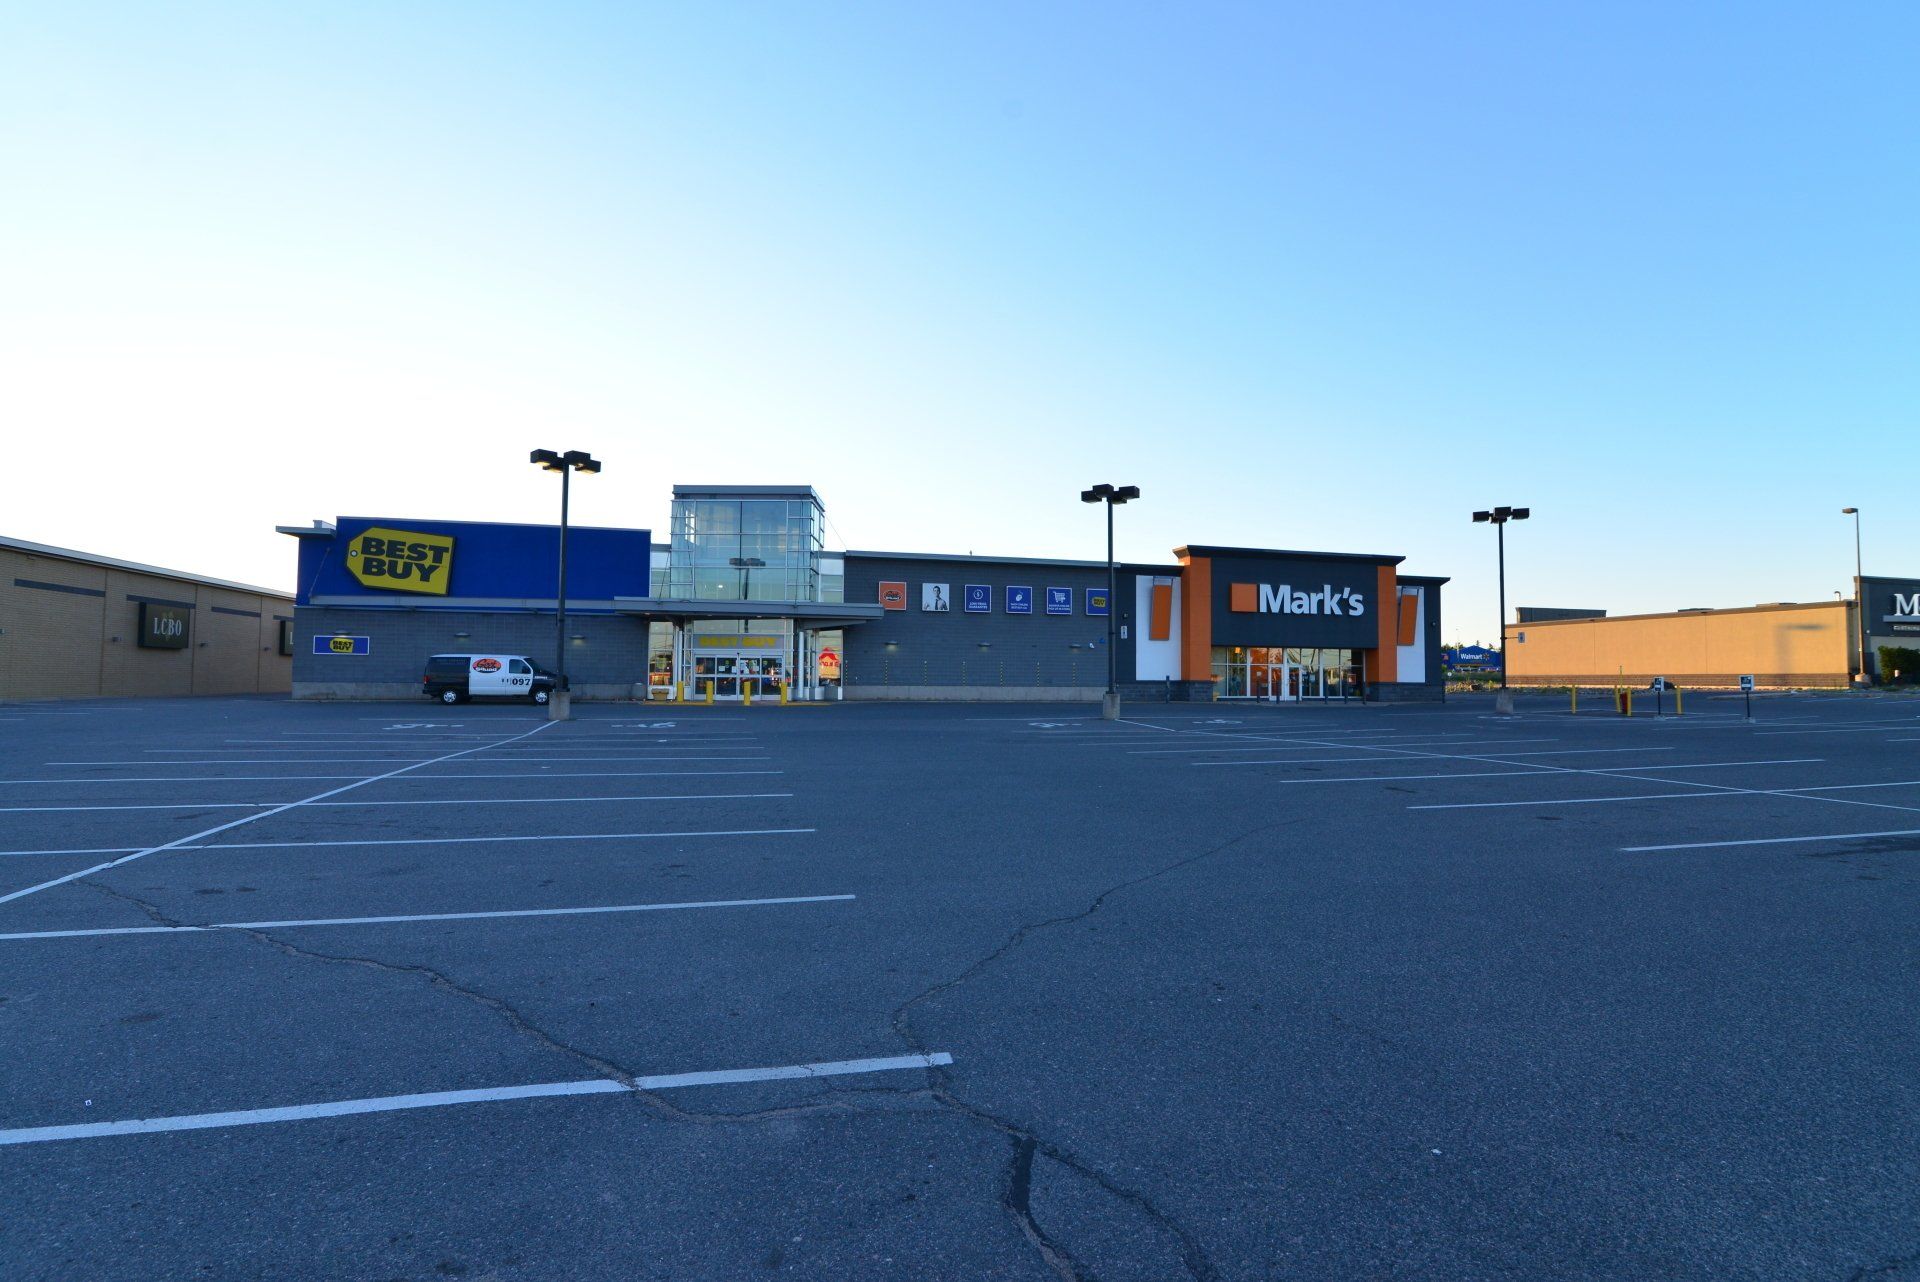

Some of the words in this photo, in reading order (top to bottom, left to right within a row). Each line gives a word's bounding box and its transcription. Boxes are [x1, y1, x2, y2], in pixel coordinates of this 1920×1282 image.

[361, 536, 449, 564] BEST
[362, 557, 440, 582] BUY
[1259, 583, 1365, 617] Mark's
[1893, 593, 1920, 617] M
[153, 617, 182, 636] LCBO
[512, 678, 531, 686] 097
